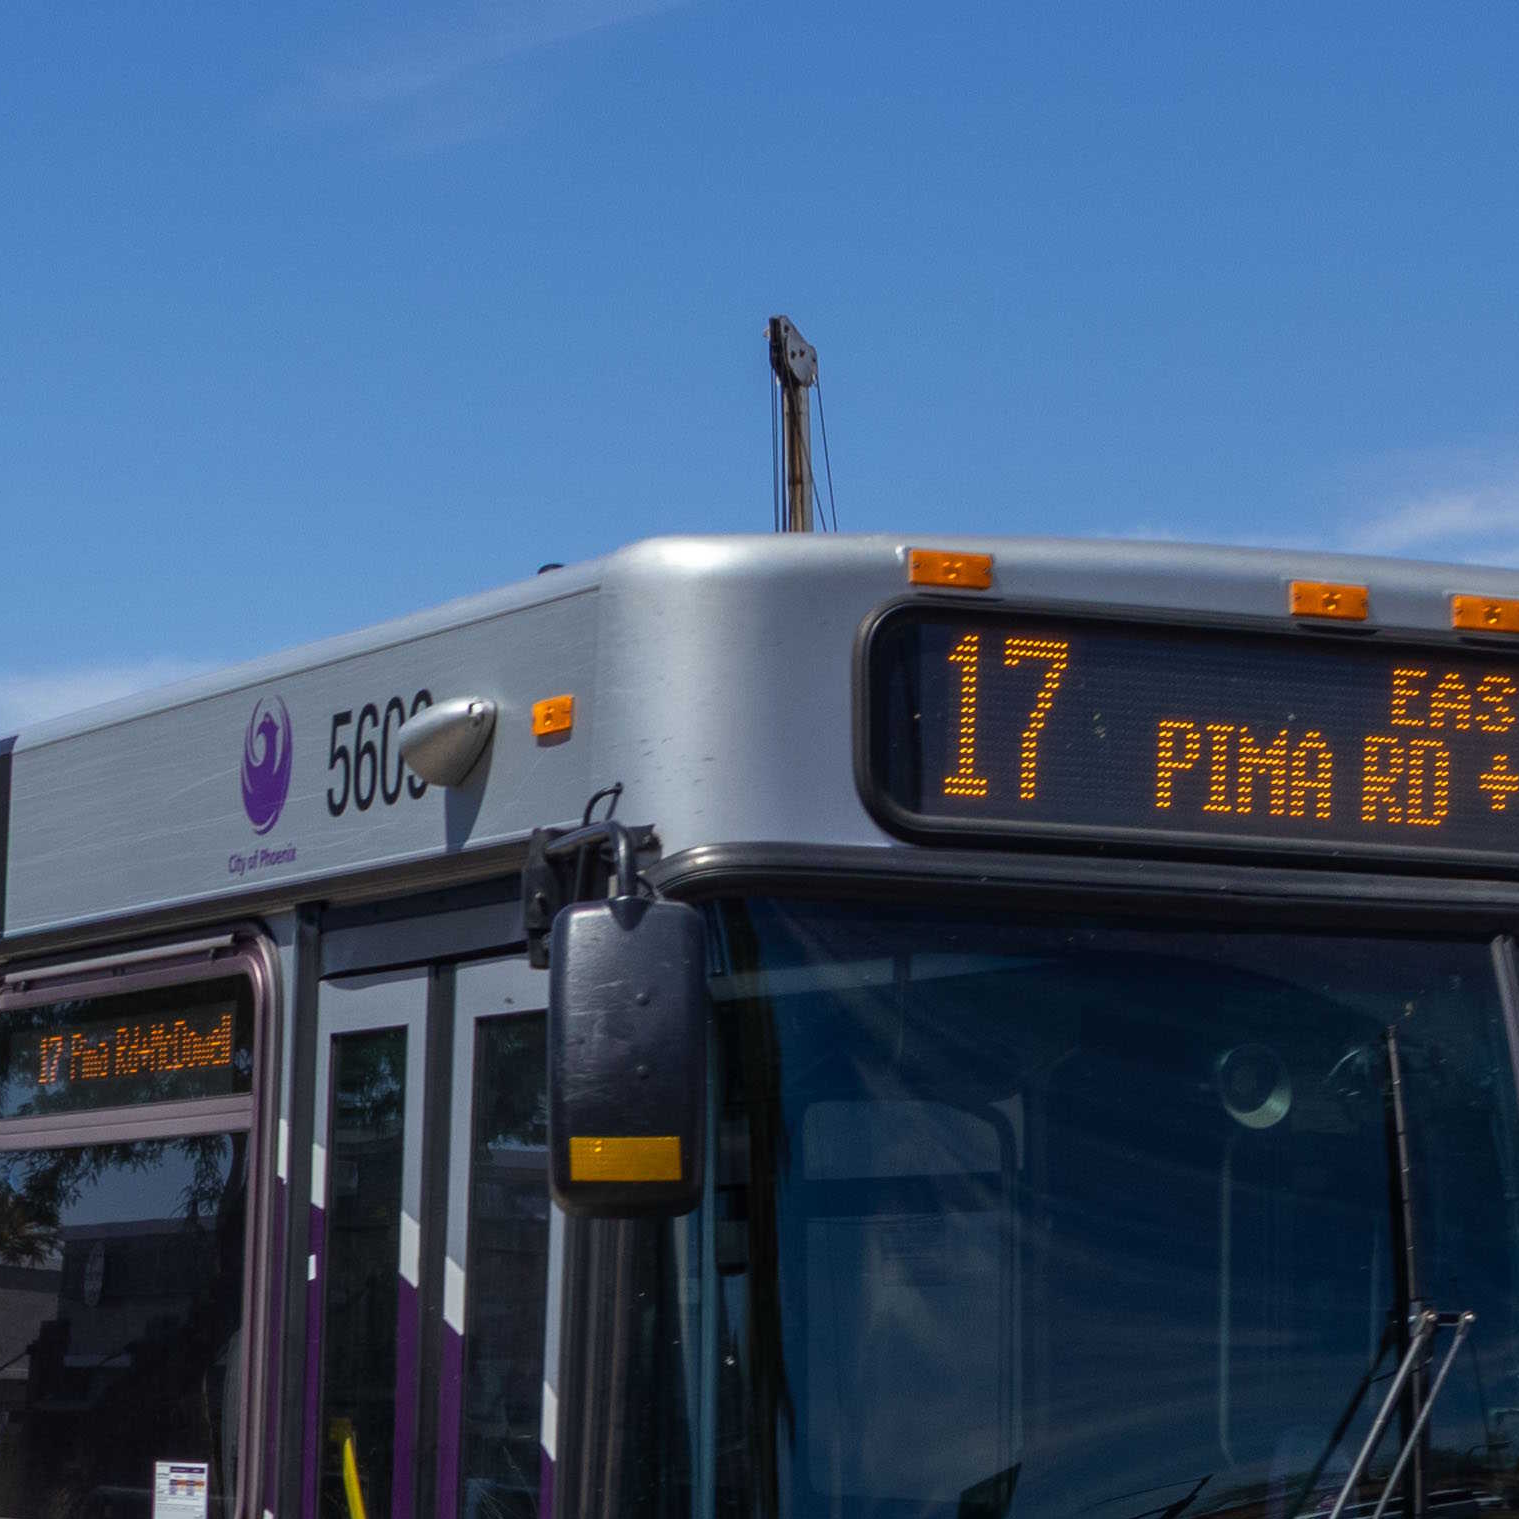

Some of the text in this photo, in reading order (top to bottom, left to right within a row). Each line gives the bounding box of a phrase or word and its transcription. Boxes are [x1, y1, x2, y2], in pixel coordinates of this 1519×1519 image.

[943, 633, 1069, 800] 17
[1154, 719, 1334, 820] PIMA
[1362, 734, 1450, 828] RD
[228, 843, 297, 877] City of Phoenix
[38, 1034, 64, 1085] 17
